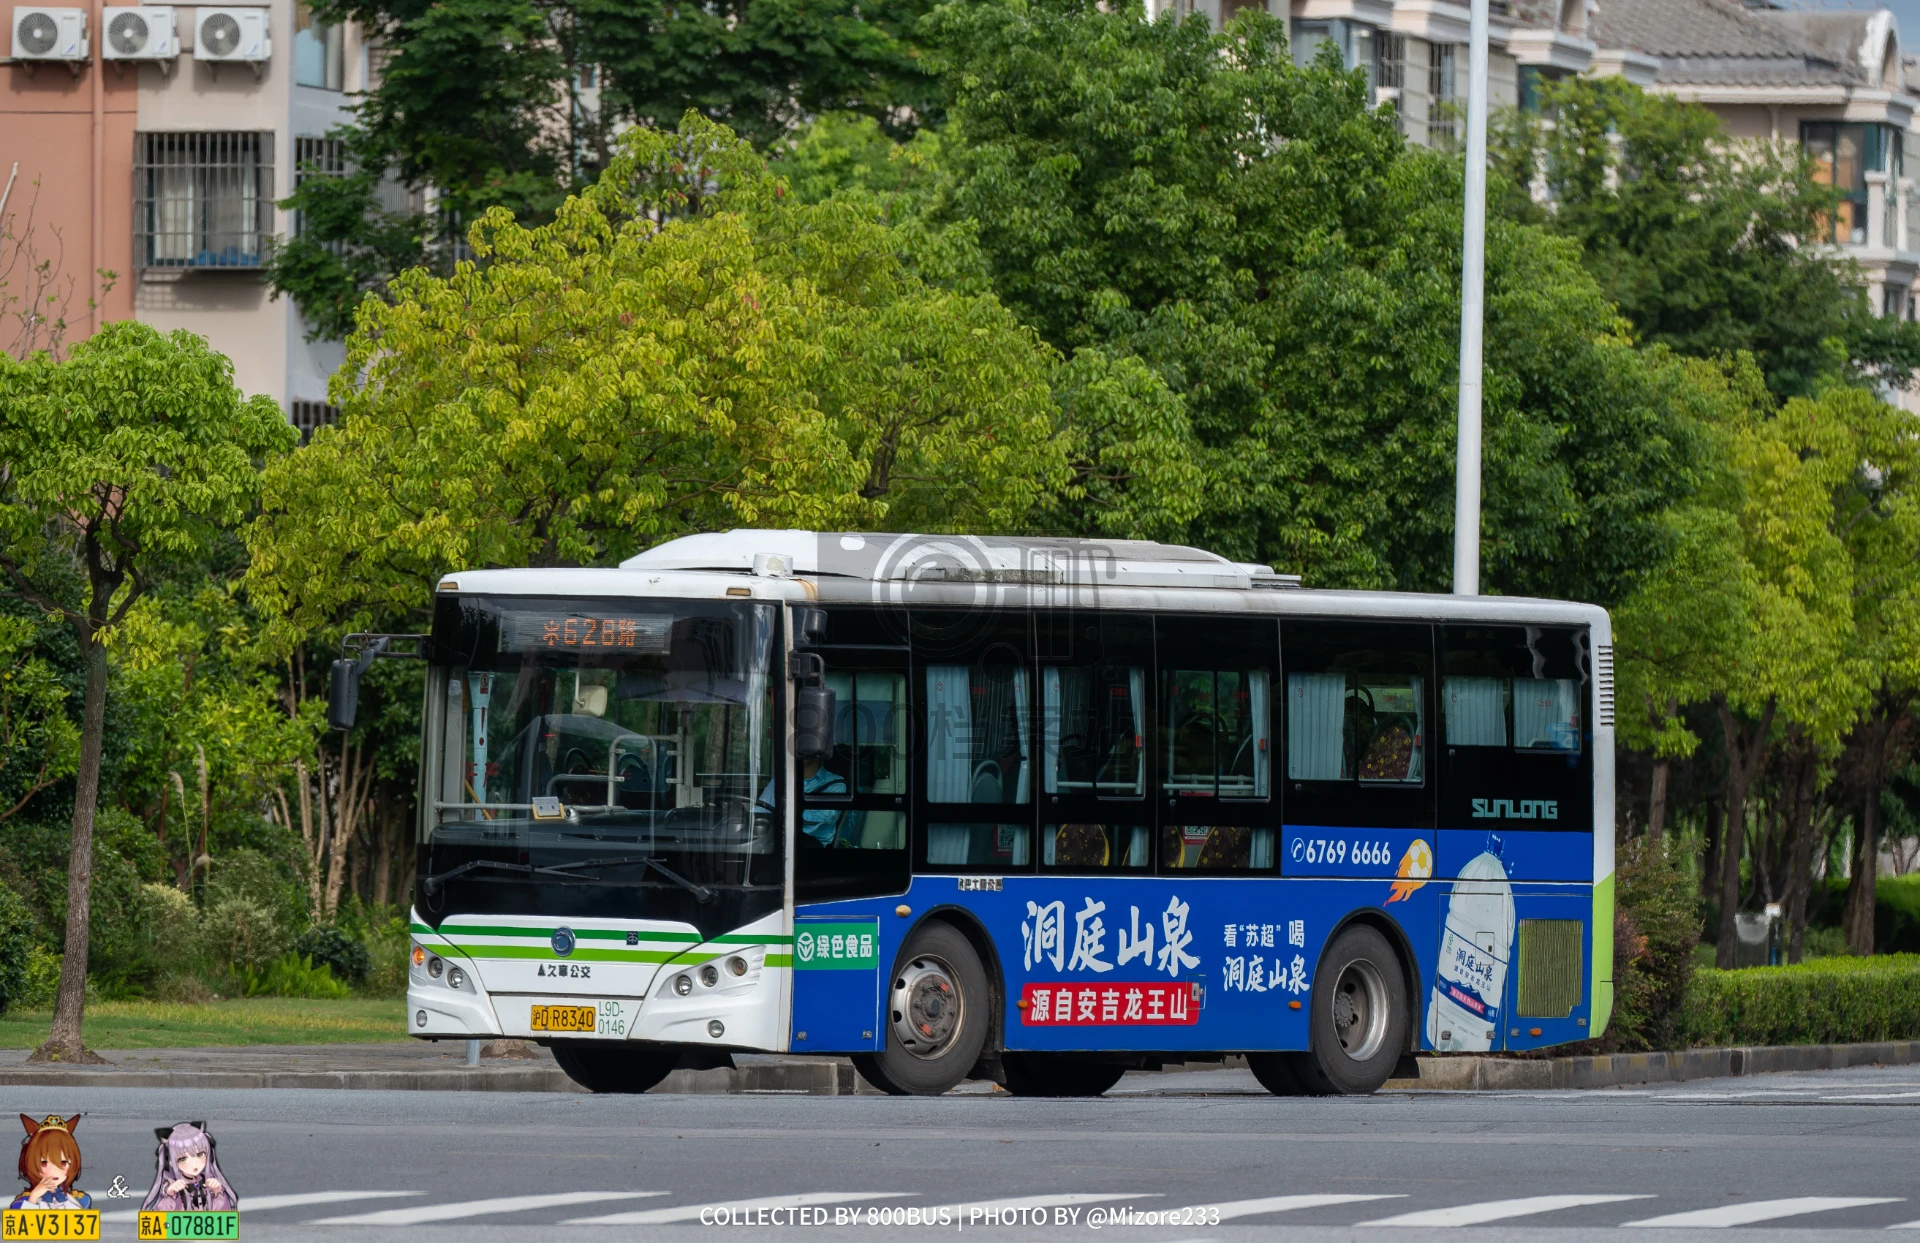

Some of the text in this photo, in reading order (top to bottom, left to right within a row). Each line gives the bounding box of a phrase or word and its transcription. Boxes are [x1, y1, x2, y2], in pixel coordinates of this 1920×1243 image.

[1471, 798, 1558, 819] SUNLONG
[1306, 838, 1391, 865] 6769 6666
[816, 934, 873, 958] 绿色食品
[1021, 895, 1201, 978] 洞庭山泉
[1222, 953, 1310, 995] 洞庭山泉
[1455, 947, 1494, 982] 洞庭山泉
[1031, 988, 1188, 1023] 源自安吉龙王山
[598, 1019, 625, 1035] 0146
